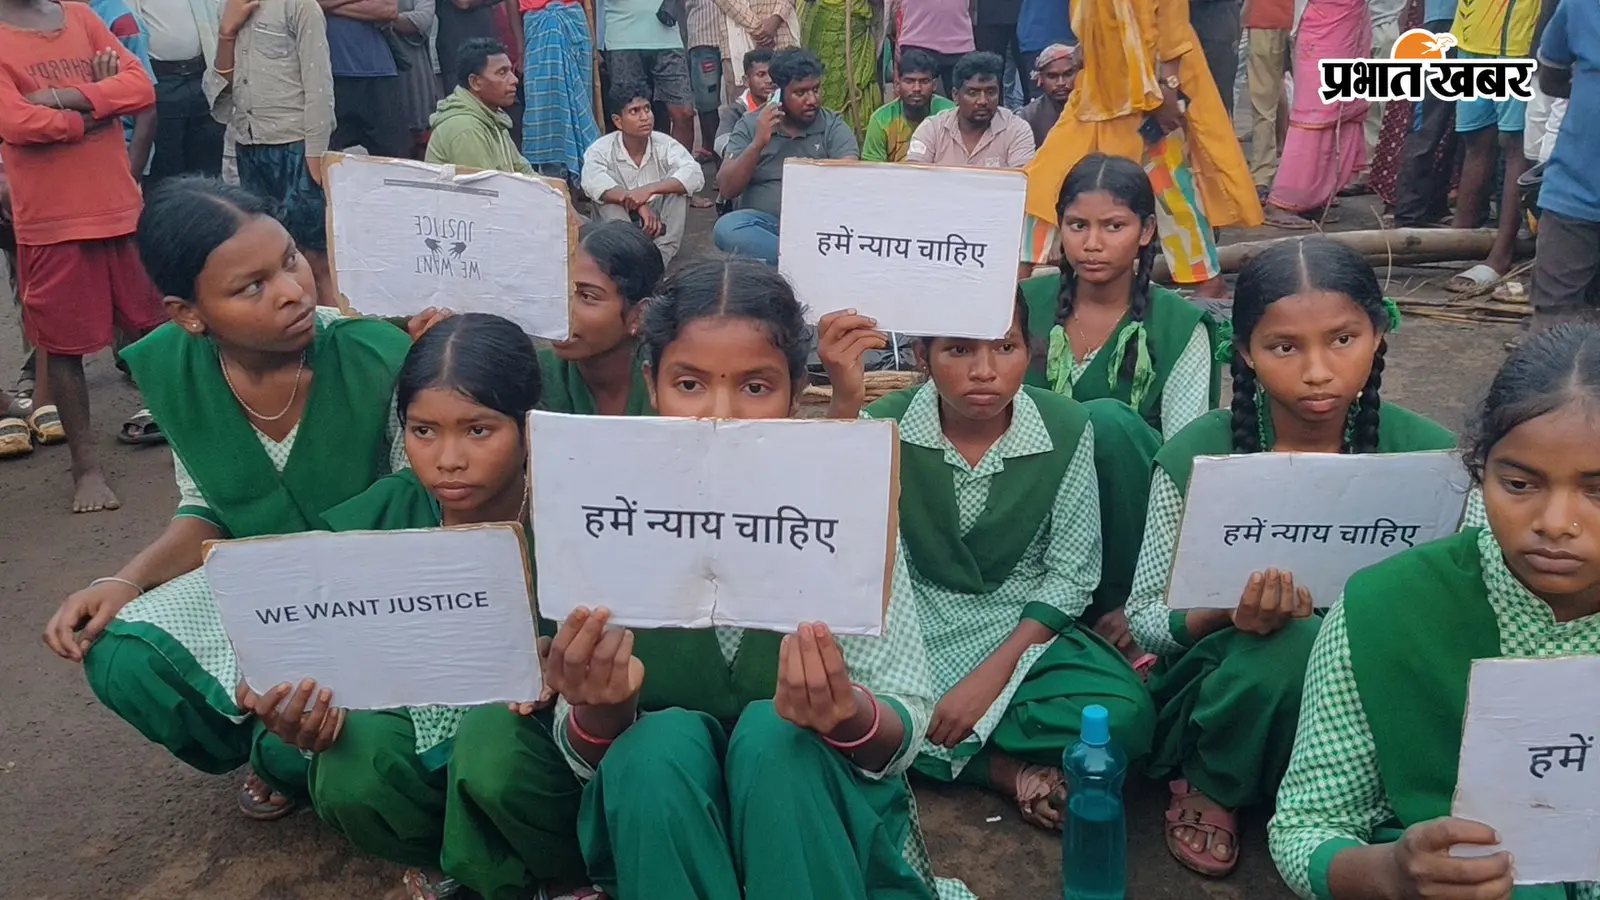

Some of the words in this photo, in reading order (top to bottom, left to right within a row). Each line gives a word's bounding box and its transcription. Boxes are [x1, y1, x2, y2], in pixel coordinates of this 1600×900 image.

[413, 215, 475, 242] JUSTICE
[816, 224, 854, 257] हमें
[857, 235, 913, 259] न्याय
[916, 233, 988, 269] चाहिए
[414, 253, 454, 277] WANT
[461, 260, 481, 281] WE
[581, 495, 638, 539] हमें
[643, 509, 726, 541] न्याय
[731, 505, 840, 554] चाहिए
[1223, 516, 1268, 547] हमें
[1271, 524, 1334, 544] न्याय
[1338, 517, 1422, 549] चाहिए
[255, 605, 300, 625] WE
[303, 599, 380, 620] WANT
[388, 590, 489, 614] JUSTICE
[1527, 733, 1595, 779] हमें
